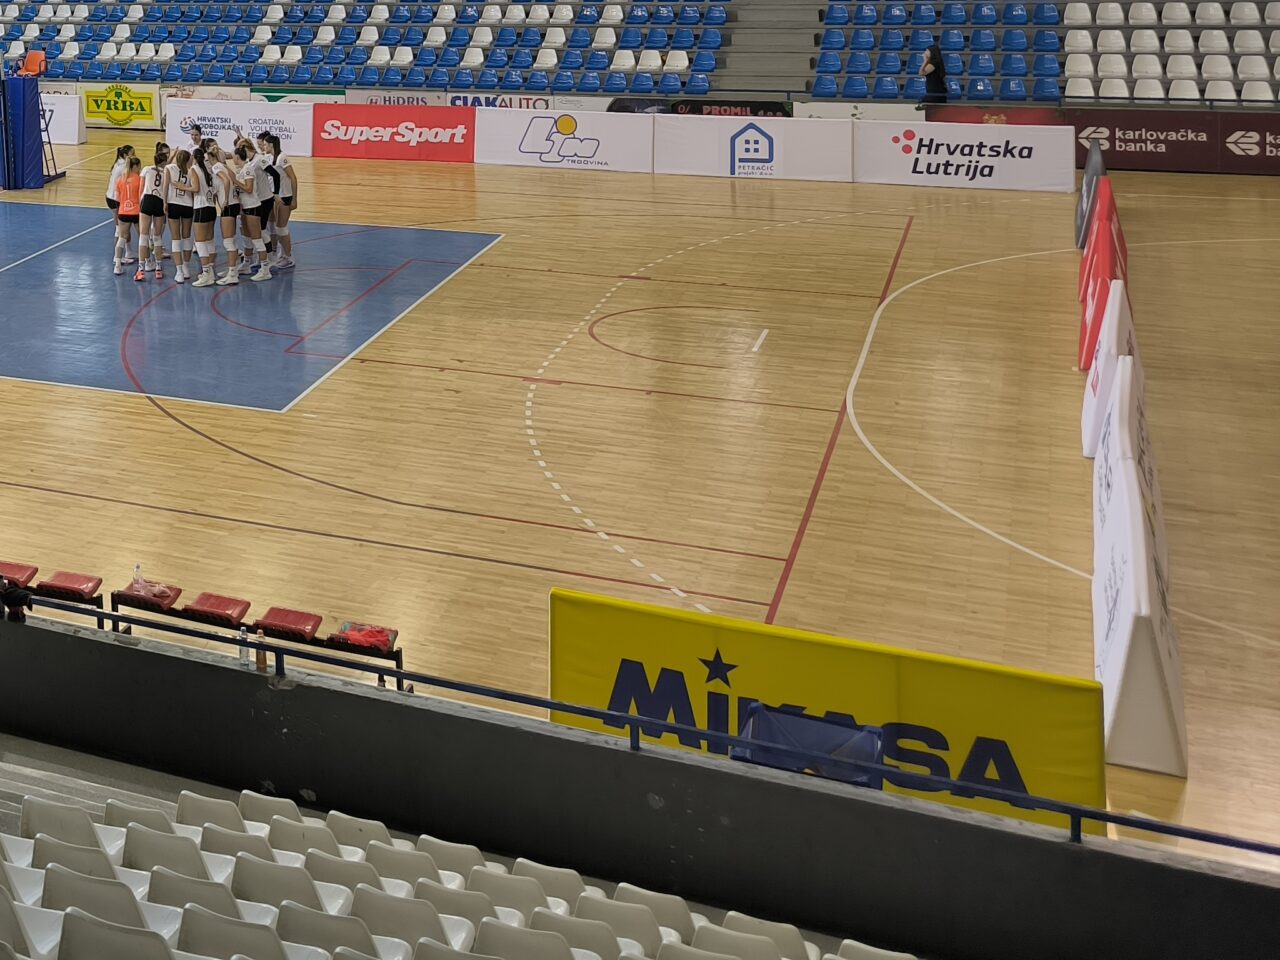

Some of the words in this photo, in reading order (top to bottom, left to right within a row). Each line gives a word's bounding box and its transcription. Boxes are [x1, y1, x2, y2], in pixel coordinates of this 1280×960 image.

[92, 99, 147, 111] VRBA
[197, 116, 232, 124] HRVATSKI
[248, 118, 285, 126] CROATIAN
[250, 125, 297, 134] VOLLEYBALL
[320, 119, 468, 147] SuperSport
[1115, 128, 1208, 141] karlovačka
[916, 138, 1034, 159] Hrvatska
[1115, 141, 1167, 153] banka
[911, 157, 994, 181] Lutrija
